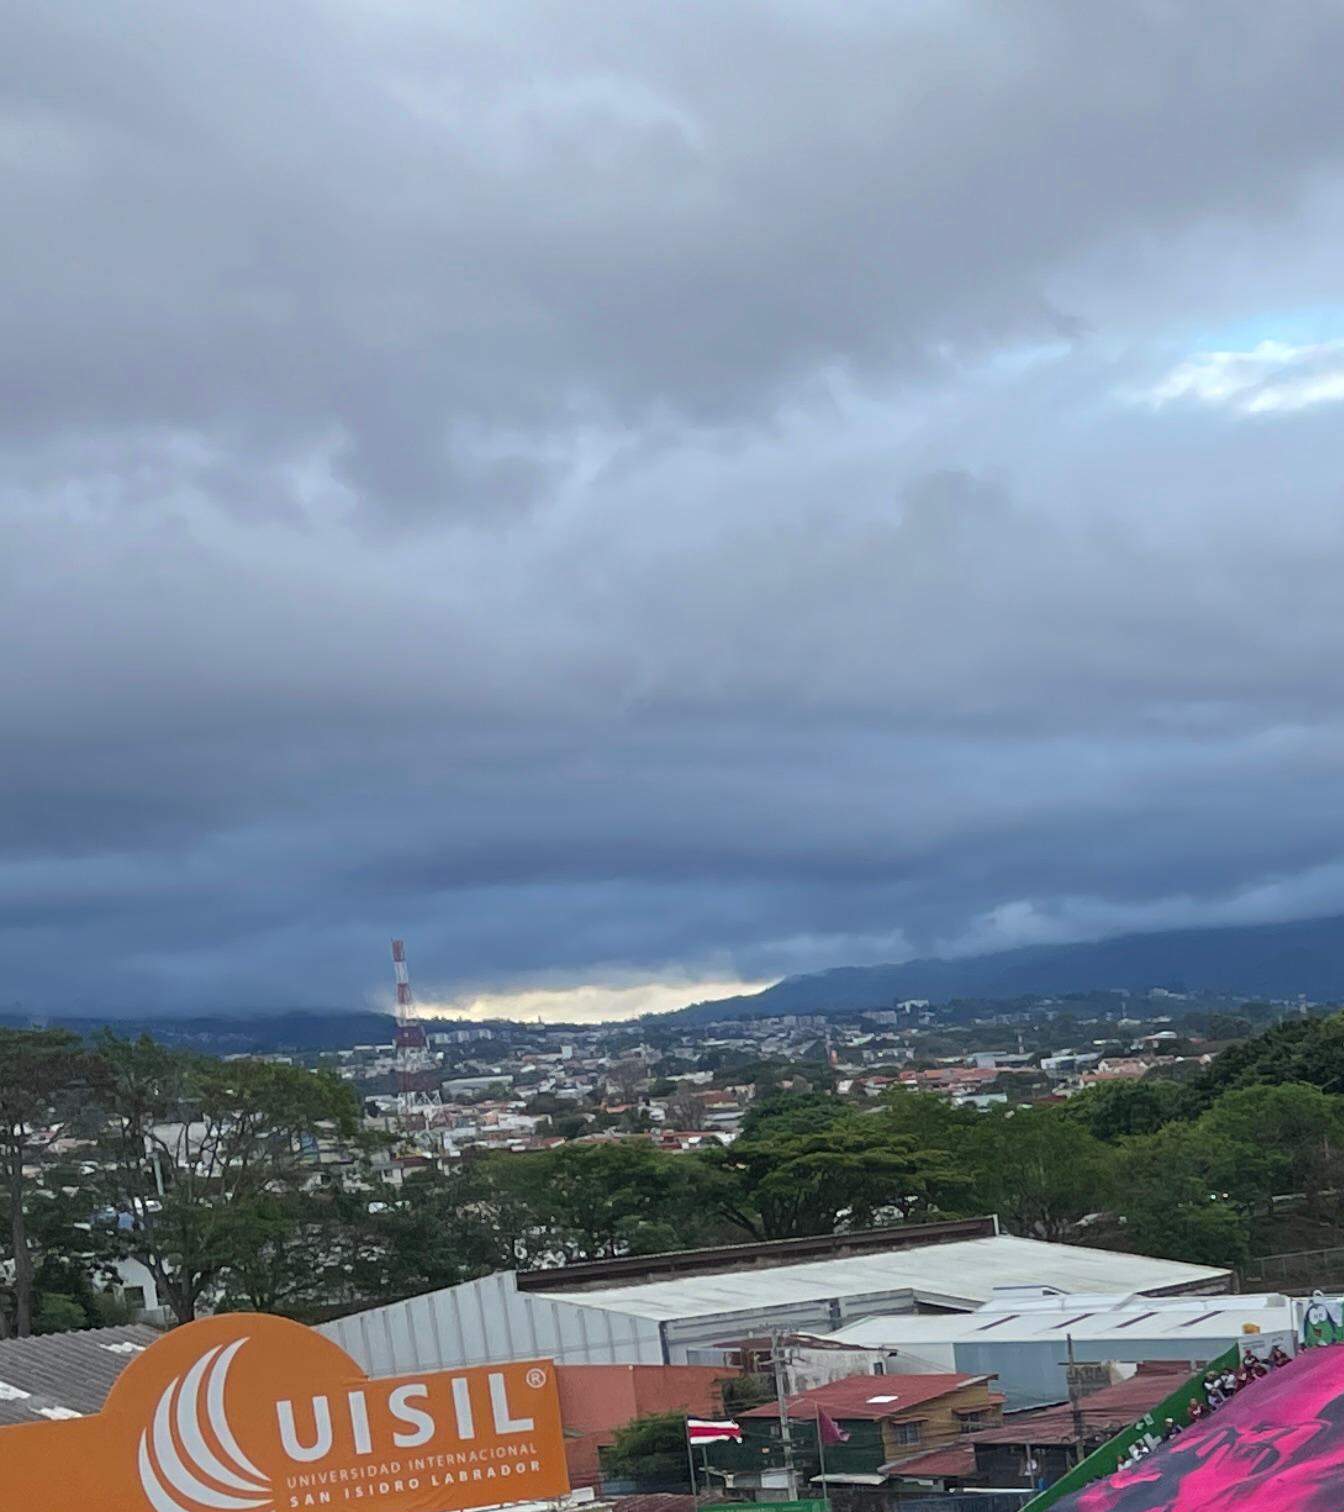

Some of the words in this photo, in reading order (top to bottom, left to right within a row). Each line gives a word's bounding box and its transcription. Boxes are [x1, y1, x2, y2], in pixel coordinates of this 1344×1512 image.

[276, 1373, 535, 1463] UISIL
[286, 1462, 400, 1490] UNIVERSIDAD
[408, 1443, 538, 1470] INTERNACIONAL
[290, 1491, 331, 1508] SAN
[344, 1479, 420, 1499] ISIDRO
[431, 1461, 541, 1486] LABRADOR
